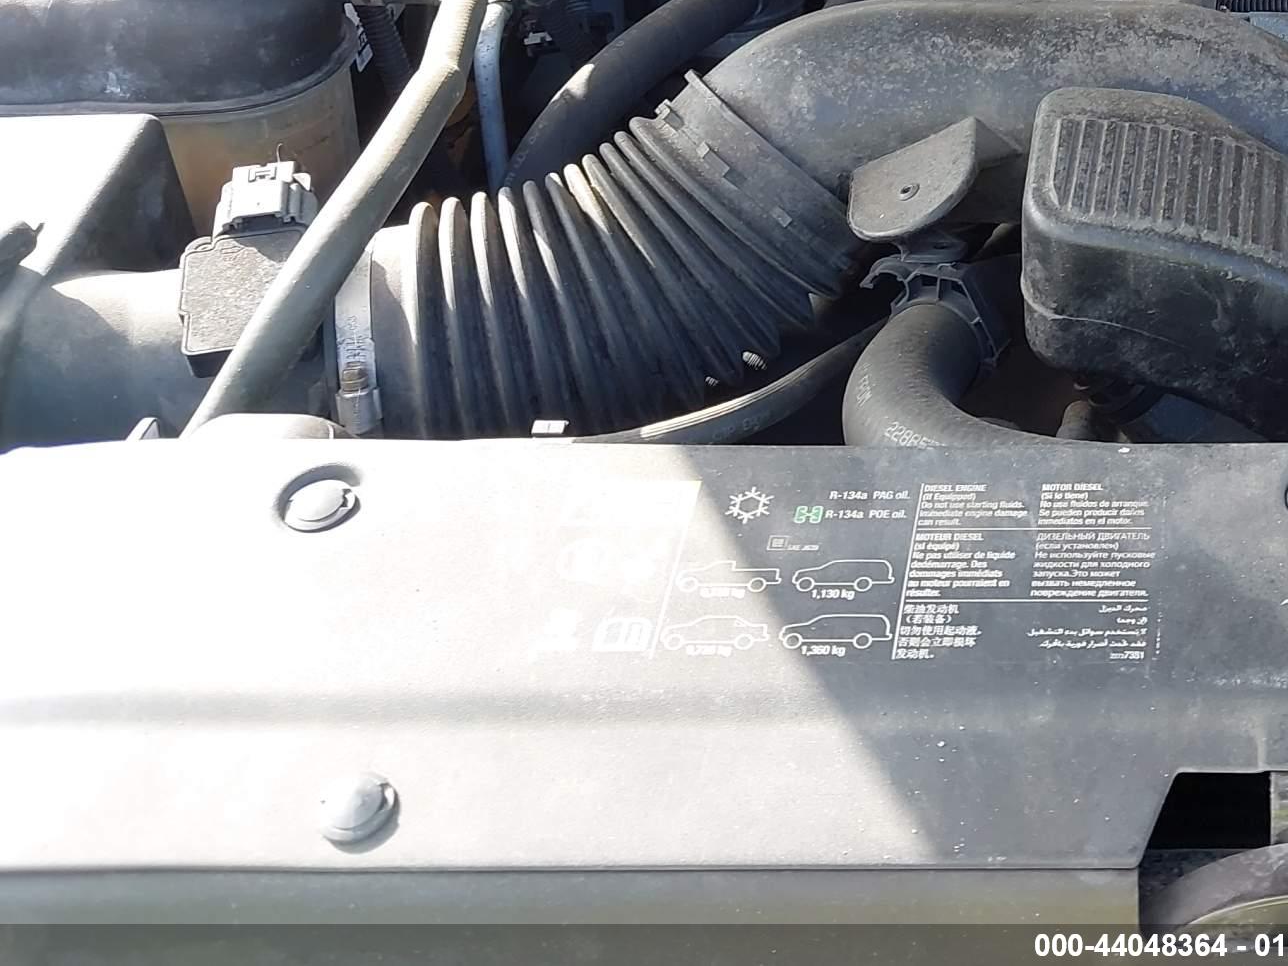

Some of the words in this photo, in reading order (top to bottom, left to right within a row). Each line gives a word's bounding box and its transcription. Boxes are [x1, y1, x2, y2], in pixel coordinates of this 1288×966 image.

[924, 484, 954, 492] DIESEL
[955, 484, 987, 492] ENGINE
[1042, 483, 1072, 491] MOTOR
[829, 491, 867, 499] R-134a
[873, 491, 893, 499] PAG
[895, 490, 910, 499] oil.
[825, 510, 864, 518] R-134a
[869, 510, 890, 518] POE
[892, 510, 907, 518] oil.
[1037, 532, 1096, 540] ДИЗЕЛЬНЫЙ
[1097, 533, 1150, 541] ДВИГАТЕЛЬ
[812, 589, 840, 599] 1,130
[841, 590, 855, 600] kg
[801, 645, 830, 656] 1,360
[831, 645, 846, 656] kg
